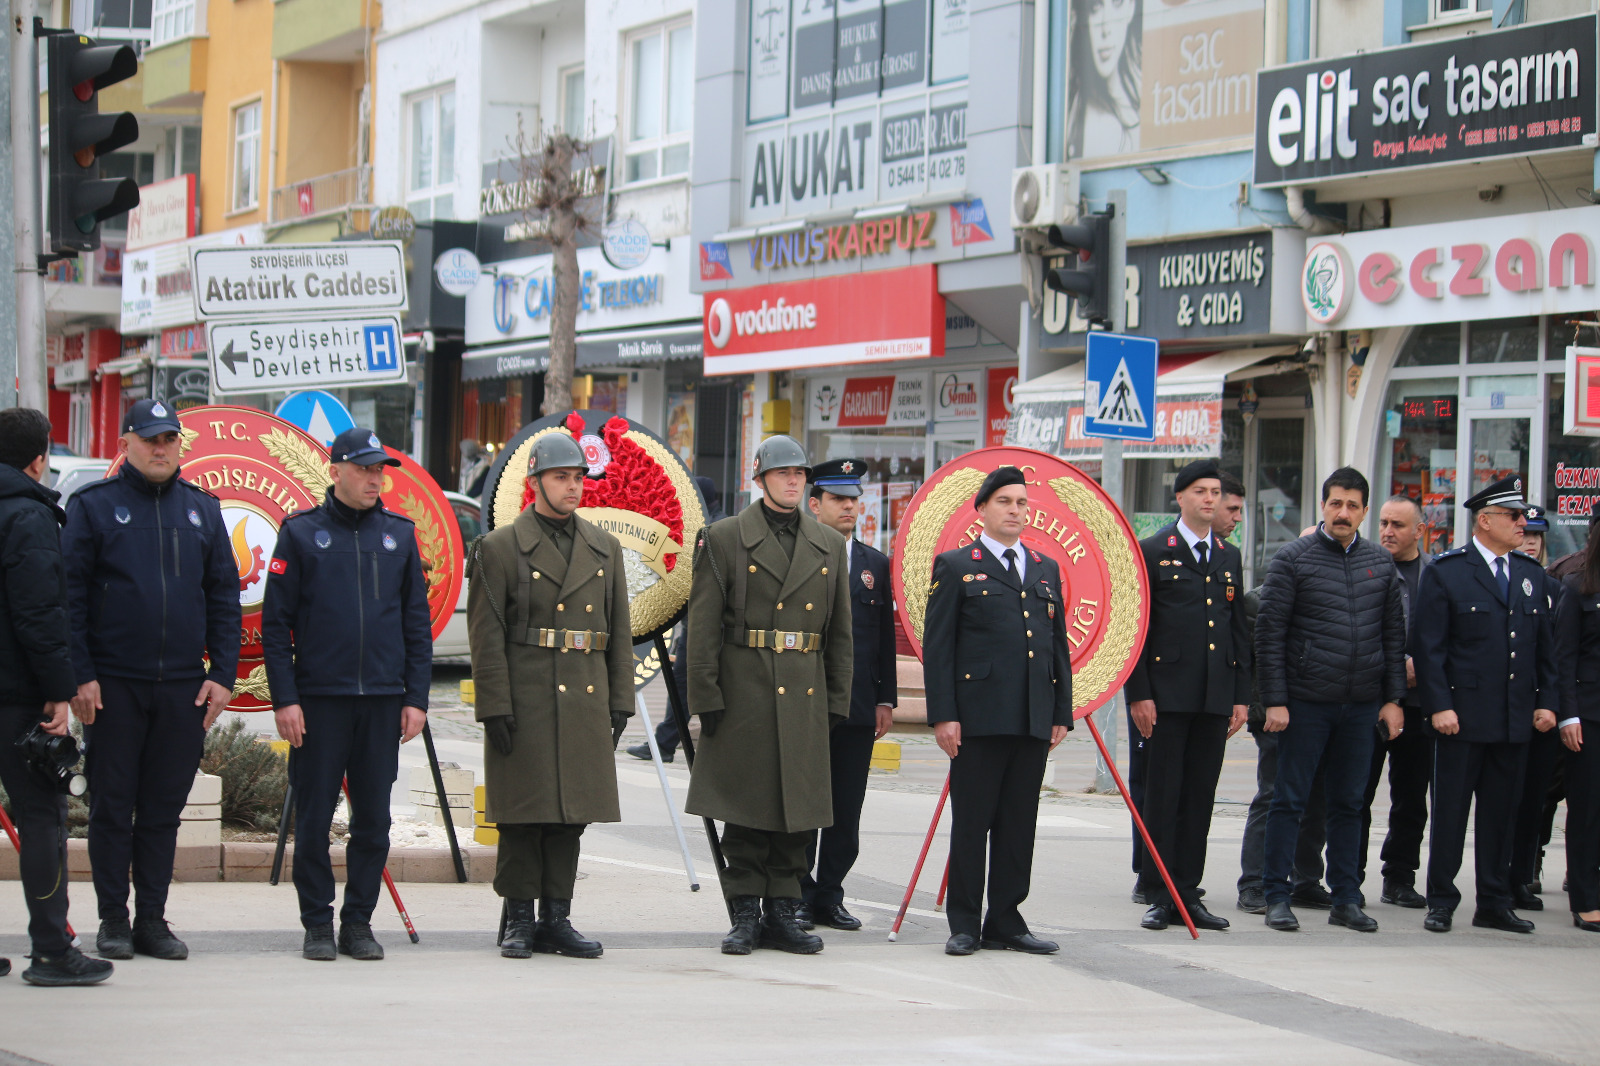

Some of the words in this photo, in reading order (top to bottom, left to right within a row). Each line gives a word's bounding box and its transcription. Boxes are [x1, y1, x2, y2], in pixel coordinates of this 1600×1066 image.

[840, 21, 877, 47] HUKUK
[854, 46, 861, 63] &
[1152, 72, 1251, 127] tasarım
[1267, 68, 1359, 167] elit
[1372, 70, 1430, 131] saç
[1443, 47, 1579, 118] tasarım
[1373, 139, 1405, 160] Derya
[1499, 126, 1507, 142] 11
[749, 121, 872, 208] AVUKAT
[888, 168, 895, 188] 0
[896, 164, 915, 186] 544
[938, 159, 951, 179] 02
[953, 156, 965, 176] 78
[747, 227, 825, 269] YUNUS
[826, 211, 934, 261] KARPUZ
[250, 250, 313, 269] SEYDİŞEHİR
[315, 250, 349, 268] İLÇESİ
[1159, 241, 1265, 288] KURUYEMİŞ
[1358, 232, 1592, 303] eczan
[206, 273, 298, 302] Atatürk
[304, 270, 398, 298] Caddesi
[524, 270, 593, 319] CAE
[597, 275, 659, 308] TELEKOM
[734, 297, 817, 337] vodafone
[1177, 294, 1194, 327] &
[1199, 290, 1243, 326] GIDA
[250, 326, 360, 356] Seydişehir
[618, 342, 640, 358] Teknik
[640, 340, 664, 356] Servis
[864, 342, 888, 357] SEMİH
[252, 356, 321, 378] Devlet
[329, 352, 368, 374] Hst.
[844, 383, 888, 418] GARANTİLİ
[897, 378, 922, 391] TEKNİK
[897, 392, 921, 406] SERVİS
[893, 412, 898, 420] &
[899, 410, 925, 421] YAZILIM
[1016, 405, 1064, 444] Özer
[1169, 408, 1212, 438] GIDA
[189, 465, 299, 516] YDİŞEHİR
[597, 519, 660, 546] KOMUTANLIĞI
